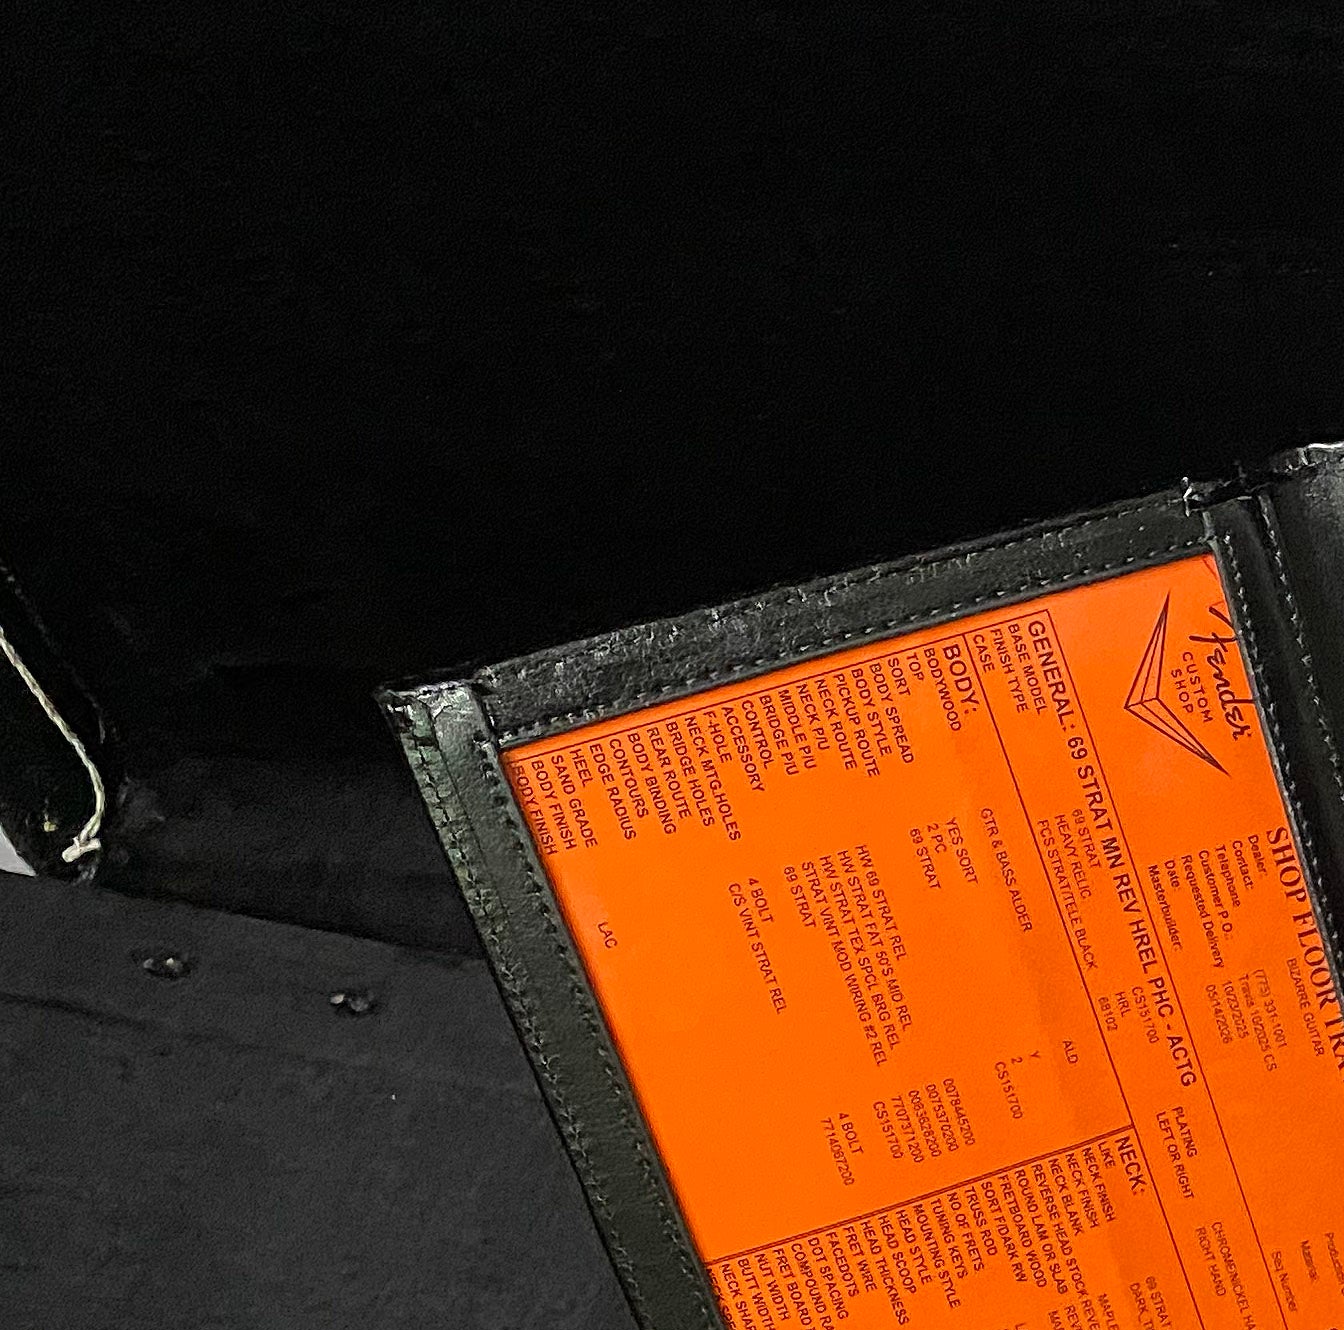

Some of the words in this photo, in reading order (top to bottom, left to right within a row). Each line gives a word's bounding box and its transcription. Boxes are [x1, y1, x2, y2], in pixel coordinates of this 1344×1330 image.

[923, 647, 962, 732] BODYWOOD
[941, 643, 980, 715] BODY:
[1027, 620, 1076, 733] GENERAL:
[1170, 668, 1194, 714] SHOP
[1182, 651, 1214, 723] CUSTOM
[1188, 601, 1252, 740] Fender
[832, 672, 862, 726] PICKUP
[853, 728, 881, 778] ROUTE
[868, 662, 894, 702] BODY
[884, 706, 915, 764] SPREAD
[1067, 736, 1088, 760] 69
[569, 748, 594, 788] HEEL
[589, 743, 615, 786] EDGE
[606, 786, 637, 840] RADIUS
[609, 738, 650, 819] CONTOURS
[665, 720, 697, 778] BRIDGE
[687, 778, 716, 827] HOLES
[1077, 764, 1113, 831] STRAT
[1100, 836, 1126, 870] MN
[1112, 872, 1142, 913] REV
[1265, 826, 1307, 903] SHOP
[1292, 910, 1338, 1011] FLOOR
[597, 921, 618, 949] LAC
[1128, 918, 1158, 975] HREL
[1146, 975, 1174, 1019] PHC
[1286, 957, 1312, 1011] BIZARRE
[1303, 1011, 1325, 1057] GUITAR
[1165, 1036, 1197, 1087] ACTG
[1114, 1135, 1148, 1196] NECK:
[964, 1185, 989, 1228] TRUSS
[979, 1229, 998, 1256] ROD
[790, 1242, 827, 1314] COMPOUND
[859, 1219, 883, 1255] HEAD
[875, 1255, 910, 1326] THICKNESS
